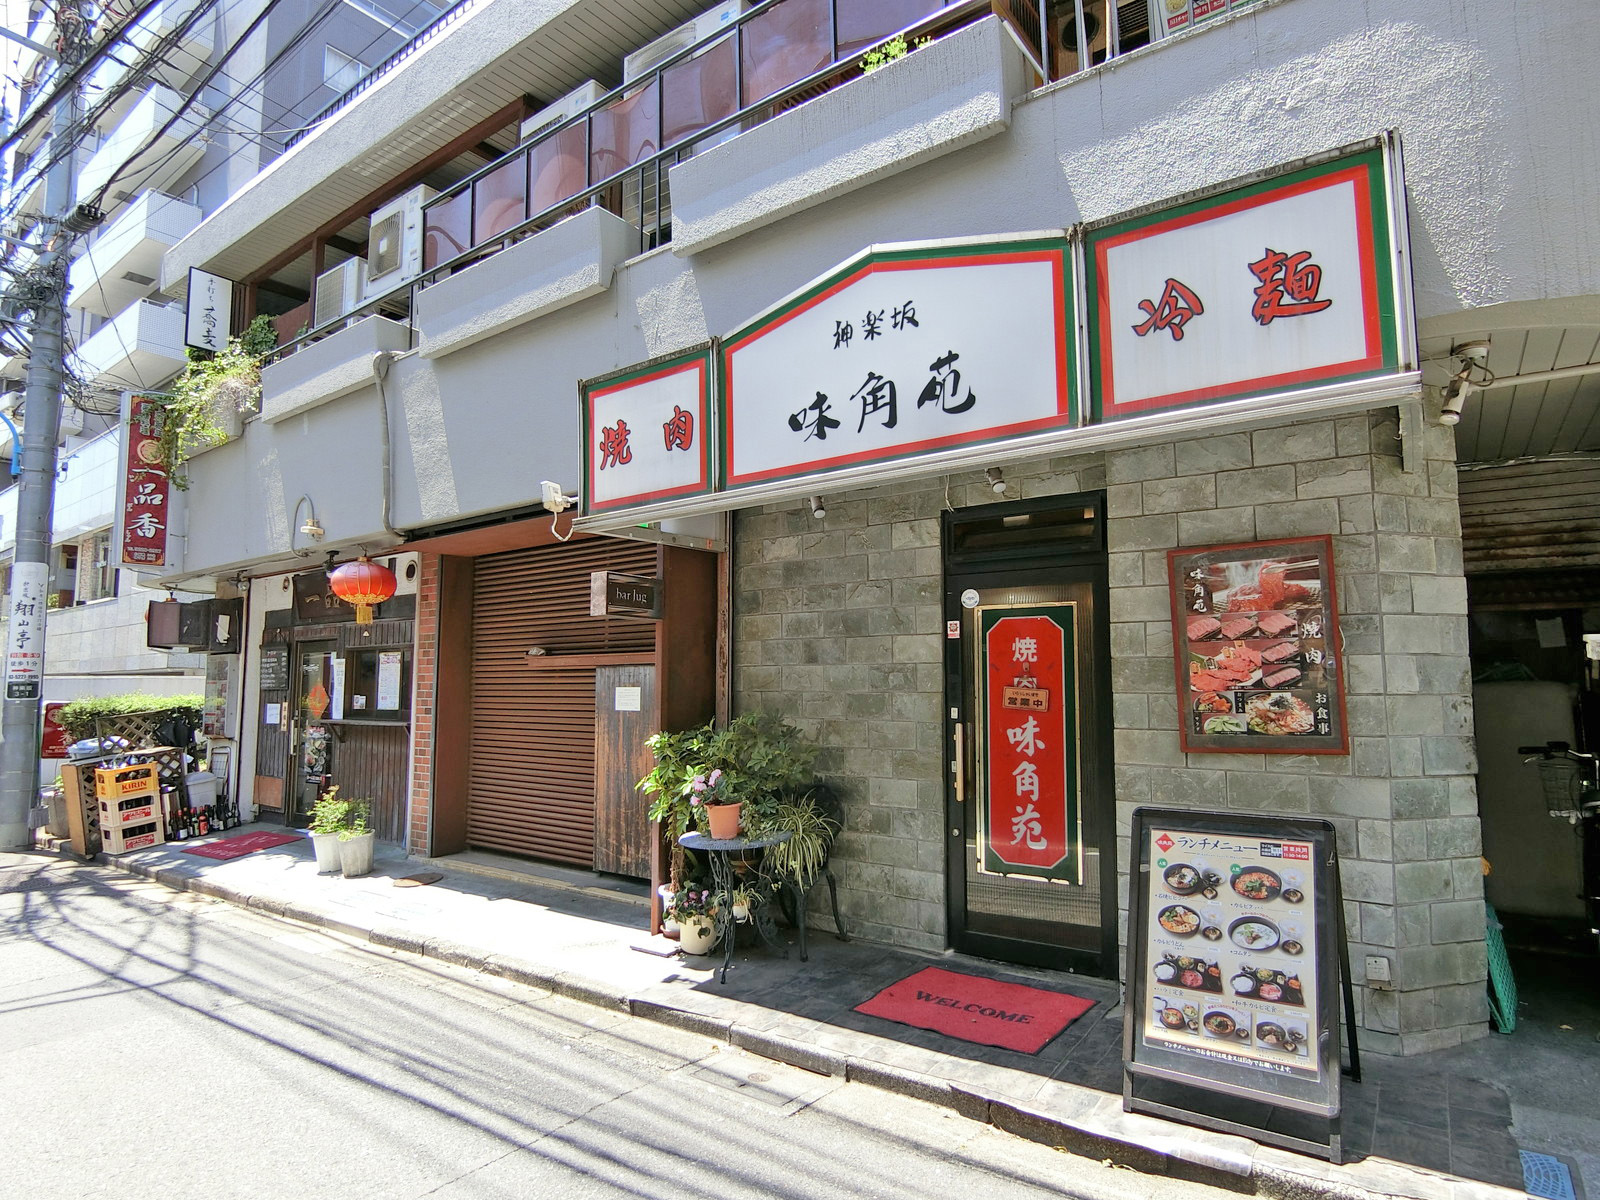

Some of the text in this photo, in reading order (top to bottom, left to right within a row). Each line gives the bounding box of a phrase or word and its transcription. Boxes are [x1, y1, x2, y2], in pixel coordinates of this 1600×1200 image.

[1131, 248, 1333, 341] 冷麺
[833, 300, 920, 350] 神楽坂
[788, 350, 976, 443] 味角苑
[599, 405, 693, 471] 焼肉
[127, 468, 167, 538] 一品香
[1189, 568, 1208, 613] 味角苑
[14, 600, 35, 649] 翔山亭
[1301, 621, 1324, 664] 焼肉
[1007, 696, 1043, 708] 営業中
[1315, 692, 1330, 736] お食事
[121, 780, 147, 791] KIRIN
[1006, 715, 1048, 850] 味角苑
[1177, 837, 1258, 852] ランチメニュー
[915, 990, 1035, 1025] WELCOME
